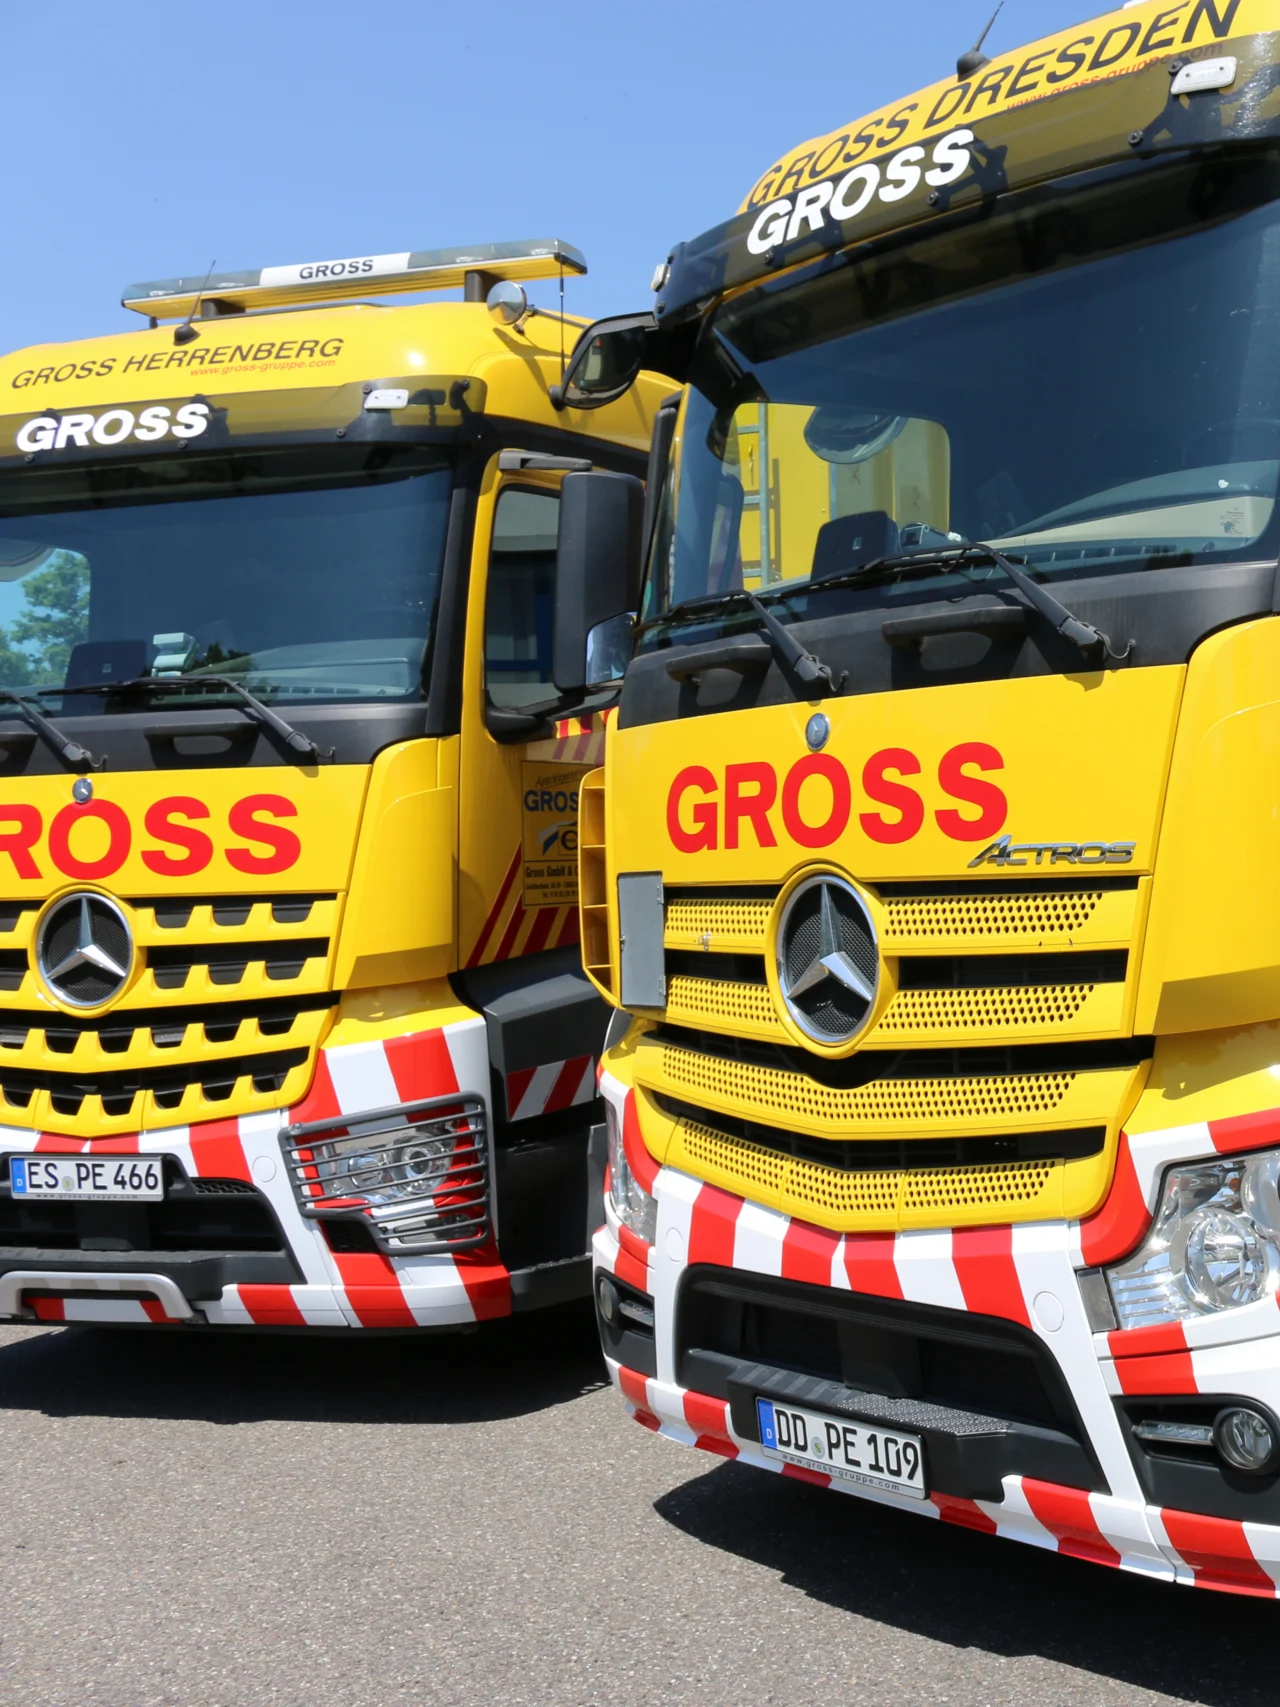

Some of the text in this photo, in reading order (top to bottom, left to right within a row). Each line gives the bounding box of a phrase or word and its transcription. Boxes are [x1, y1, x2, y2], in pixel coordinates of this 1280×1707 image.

[747, 0, 1241, 212] GROSS DRESDEN
[746, 128, 975, 255] GROSS
[298, 259, 375, 280] GROSS
[11, 337, 345, 389] GROSS HERRENBERG
[189, 358, 337, 377] www.gross-gruppe.com
[16, 402, 210, 452] GROSS
[666, 741, 1008, 854] GROSS
[0, 793, 302, 881] ROSS
[967, 834, 1137, 869] ACTROS
[16, 1161, 159, 1191] D ES PE 466
[766, 1408, 919, 1481] D DD PE 109
[781, 1453, 900, 1492] www.gross-gruppe.com
